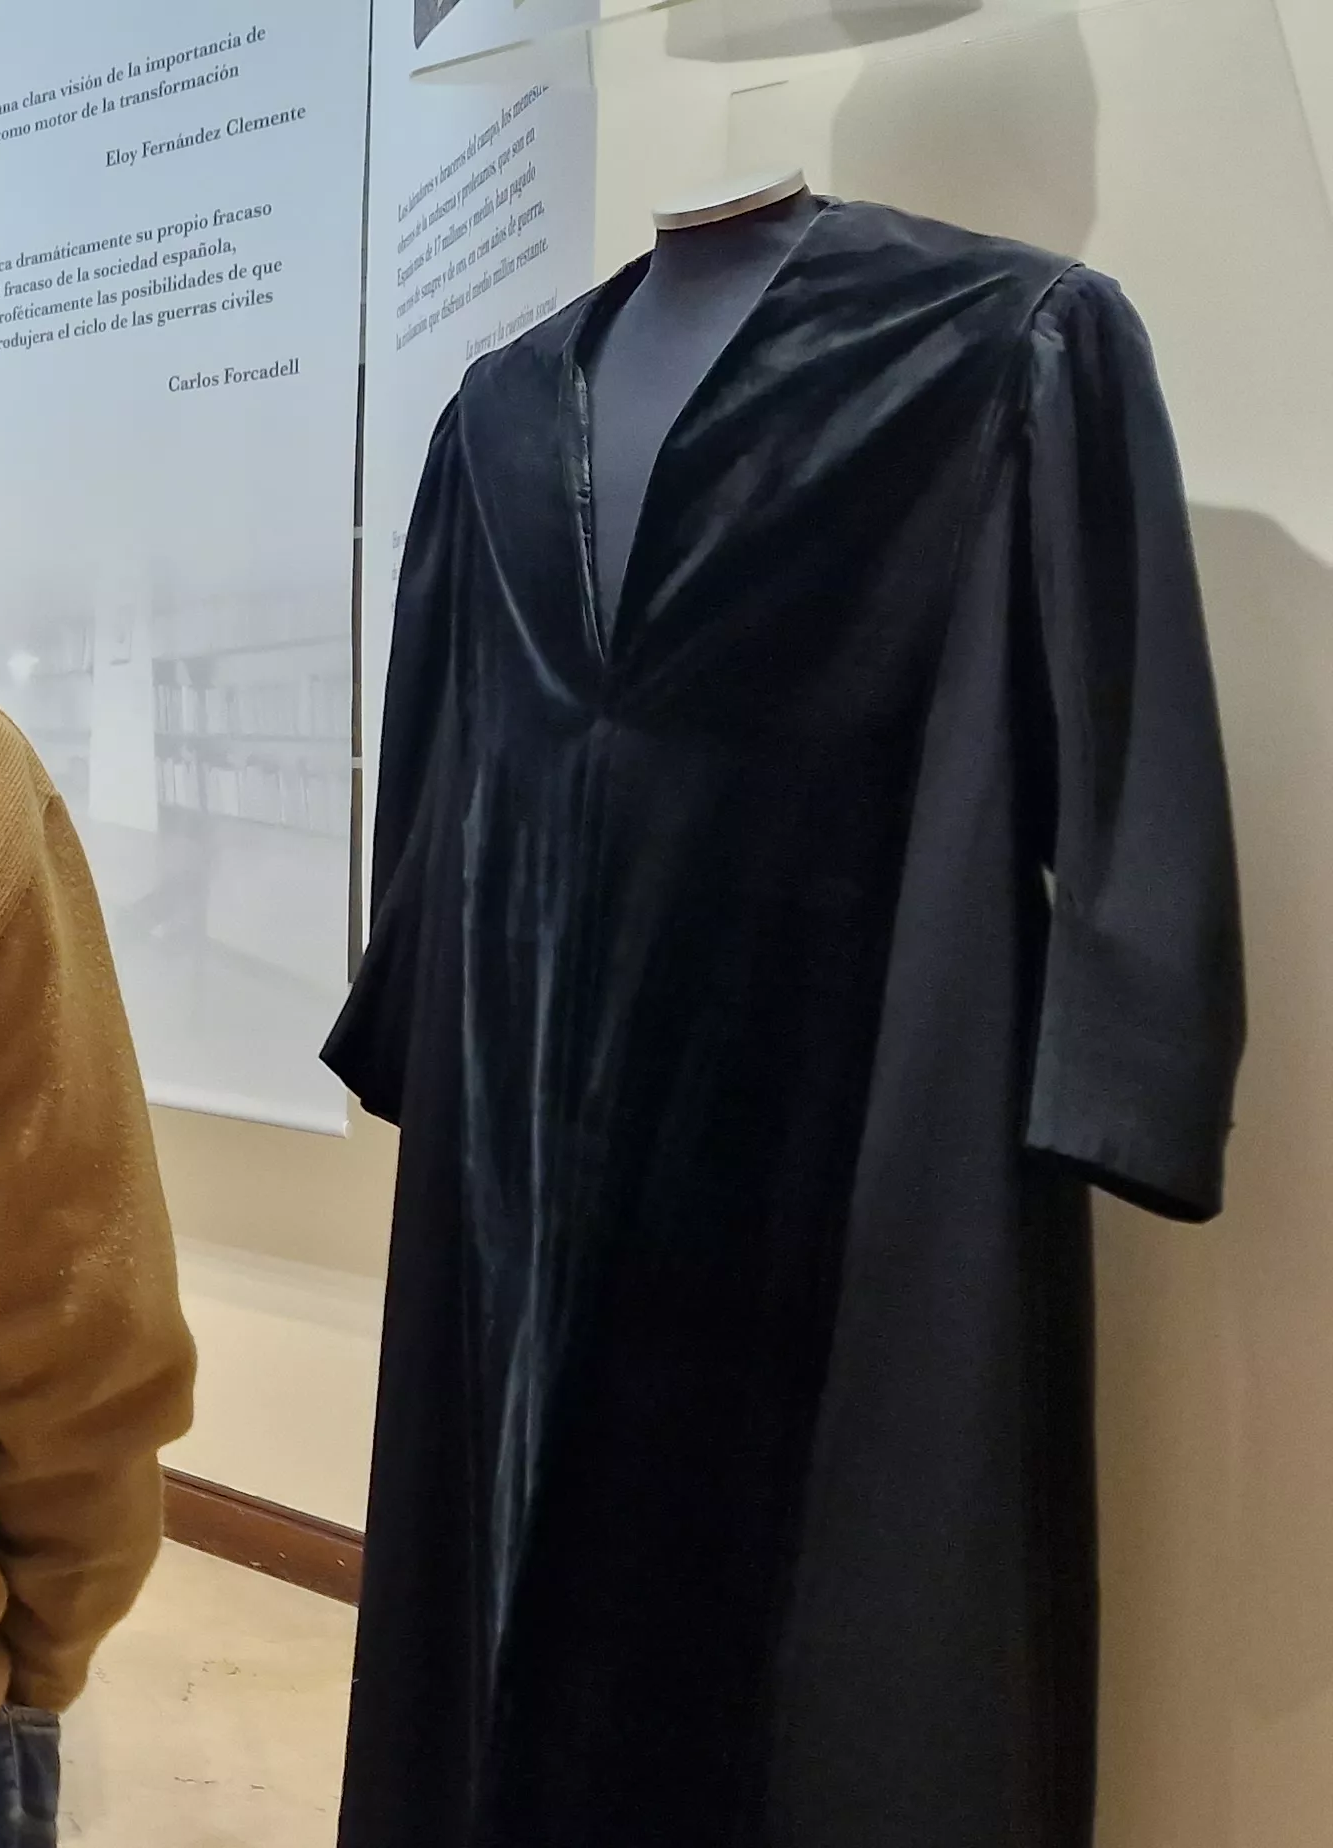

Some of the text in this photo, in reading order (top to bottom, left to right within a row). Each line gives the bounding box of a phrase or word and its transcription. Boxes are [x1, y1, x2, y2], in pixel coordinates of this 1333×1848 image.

[23, 90, 56, 108] clara
[60, 74, 102, 97] visión
[107, 67, 123, 84] de
[128, 62, 141, 78] la
[145, 32, 241, 73] importancia
[247, 25, 265, 44] de
[35, 111, 77, 132] motor
[81, 102, 98, 118] de
[102, 97, 115, 113] la
[120, 64, 239, 108] transformación
[106, 107, 306, 167] Eloy Fernández Clemente
[525, 127, 535, 146] en
[509, 161, 536, 205] pagado
[16, 234, 132, 268] dramáticamente
[136, 230, 153, 243] su
[157, 214, 208, 244] propio
[213, 204, 271, 226] fracaso
[4, 278, 53, 297] fracaso
[57, 270, 73, 286] de
[77, 267, 90, 282] la
[94, 251, 157, 279] sociedad
[163, 238, 236, 267] española,
[169, 358, 299, 392] Carlos Forcadell
